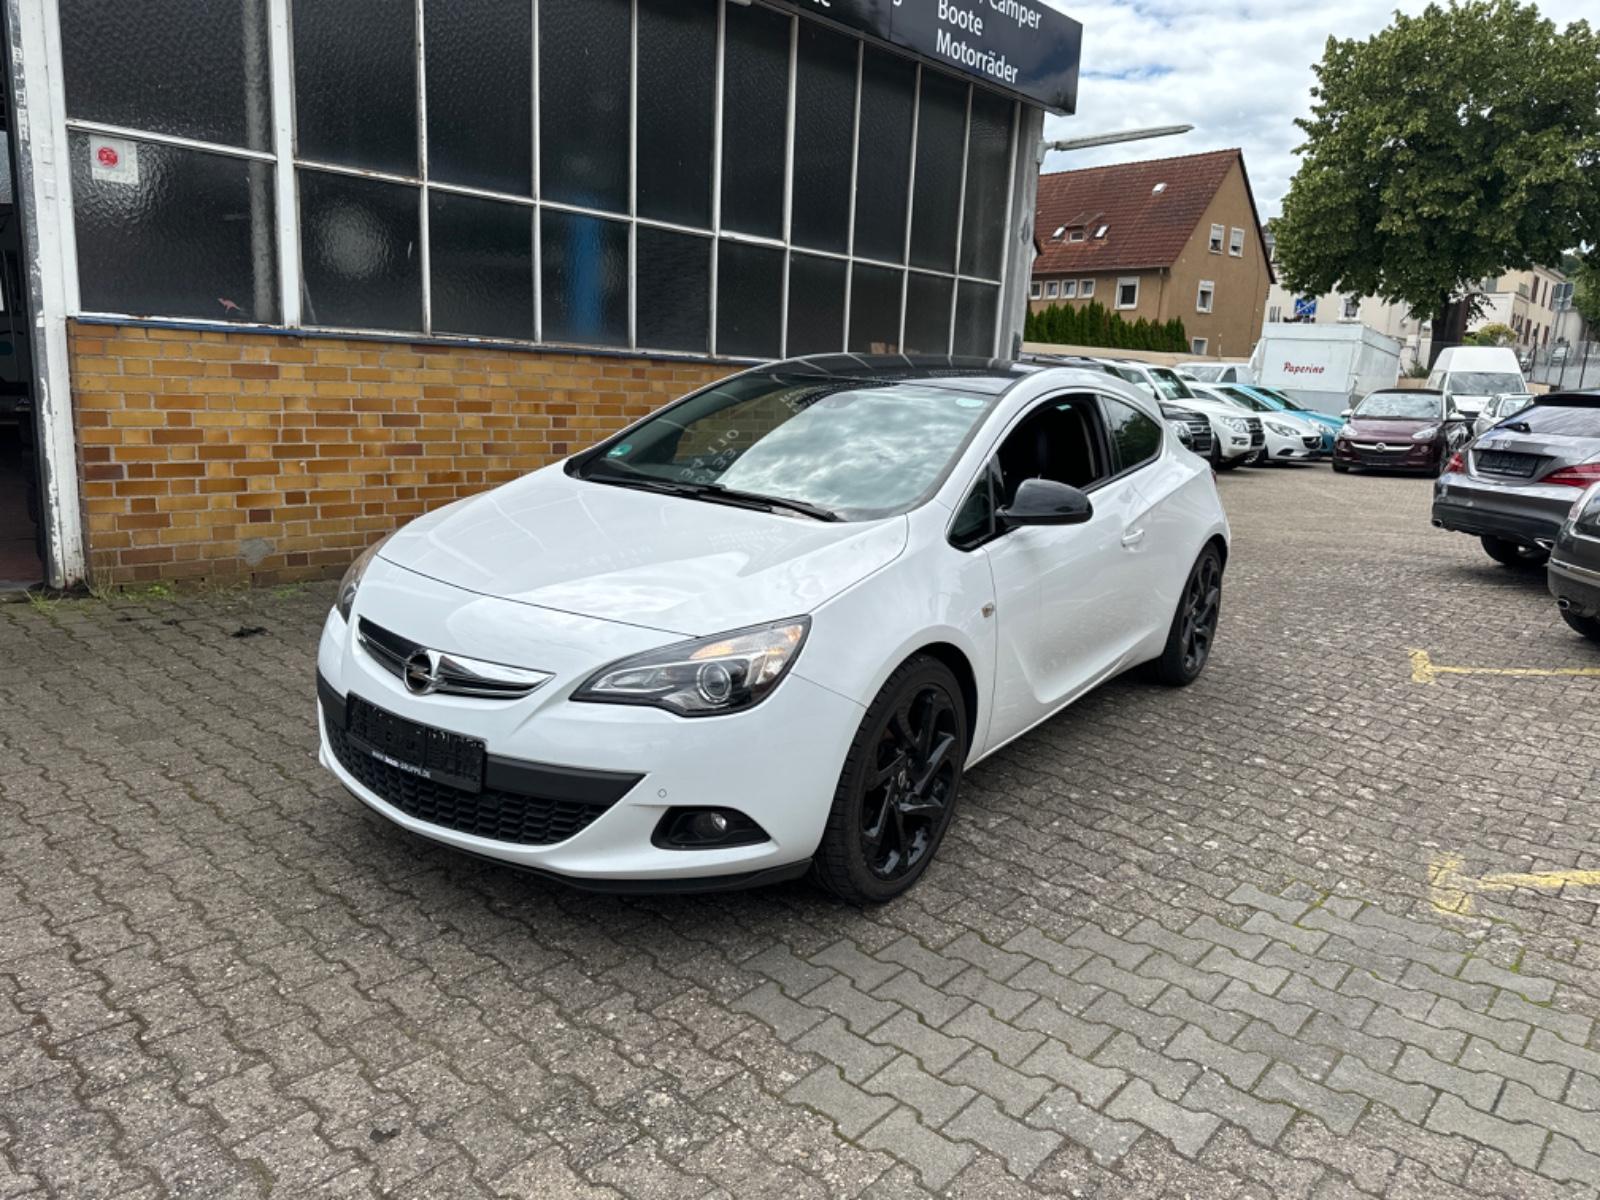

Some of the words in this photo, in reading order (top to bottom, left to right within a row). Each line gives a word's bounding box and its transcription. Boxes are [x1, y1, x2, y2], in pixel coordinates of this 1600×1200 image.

[938, 0, 983, 36] Boote
[936, 28, 1018, 84] Motorräder
[1283, 361, 1325, 375] Paperino
